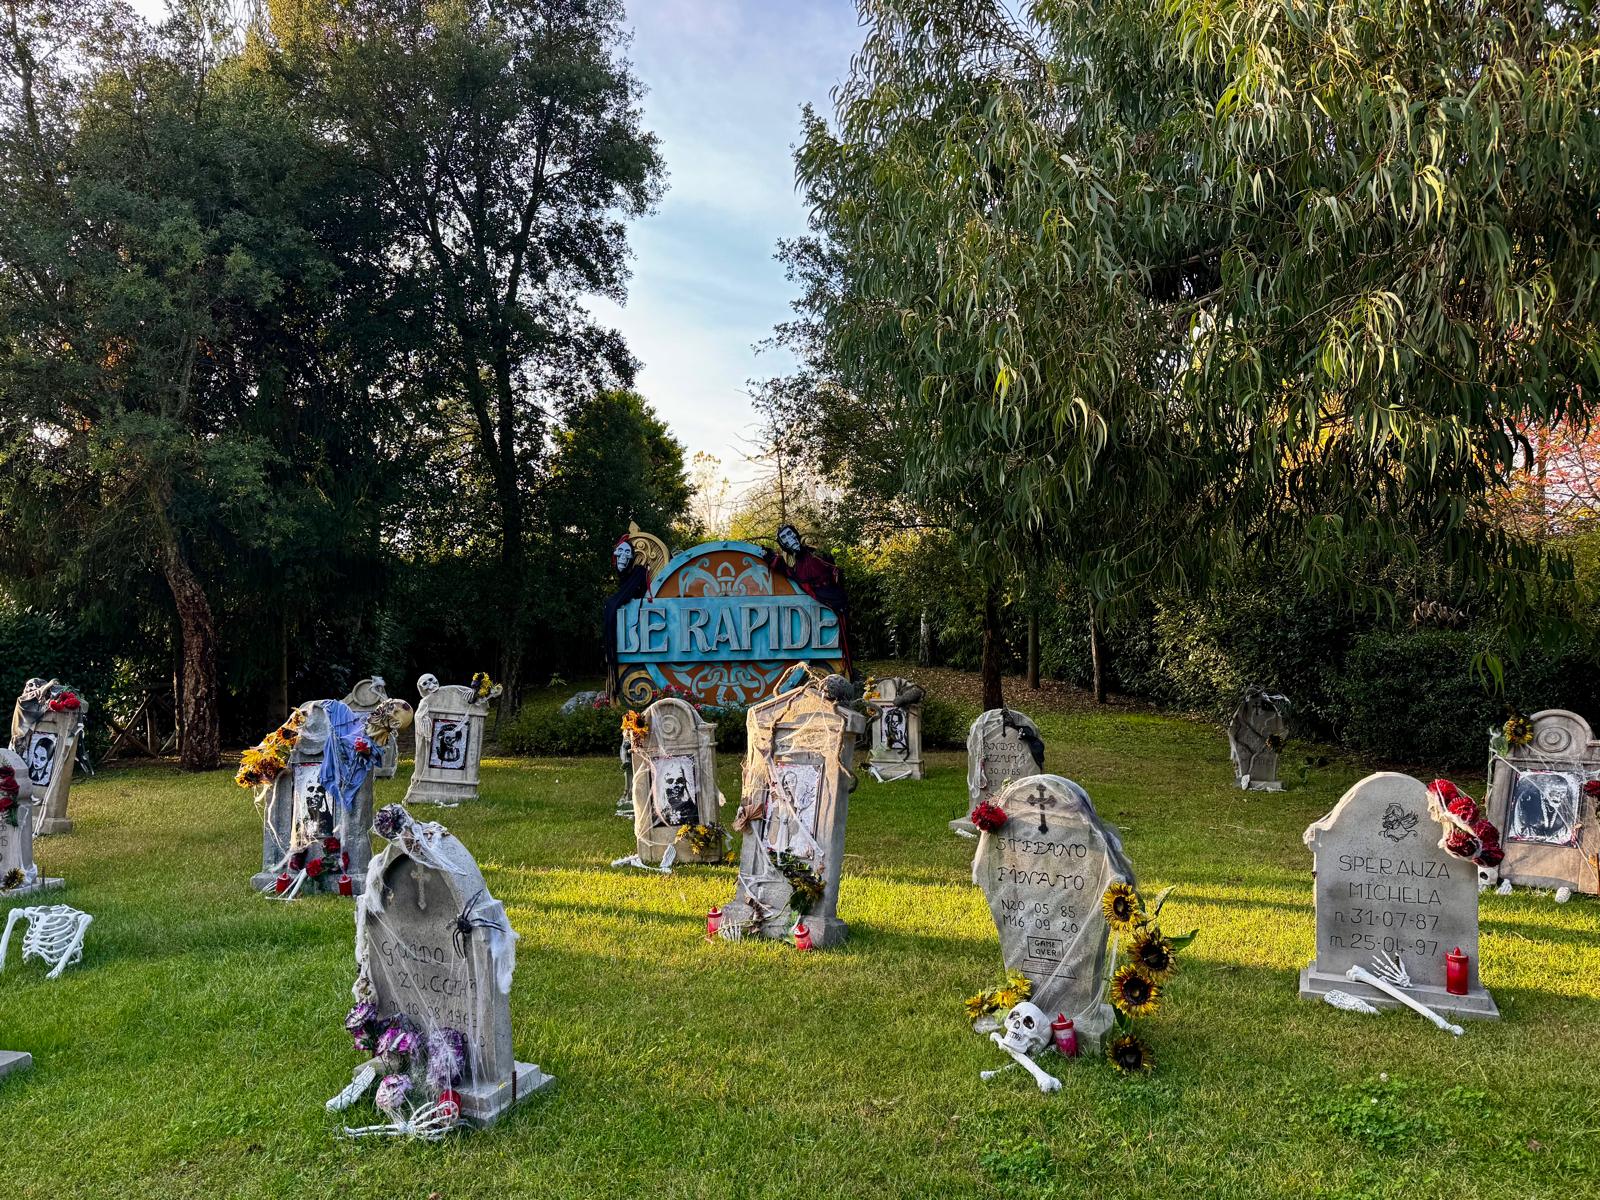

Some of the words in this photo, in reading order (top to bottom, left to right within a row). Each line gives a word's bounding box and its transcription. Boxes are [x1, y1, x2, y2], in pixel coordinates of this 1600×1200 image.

[617, 608, 668, 653] LE
[680, 605, 839, 652] RAPIDE
[1339, 855, 1450, 879] SPERANZA
[997, 865, 1085, 890] FINATO
[1349, 881, 1442, 905] MICHELA
[1034, 903, 1050, 915] 05
[1060, 905, 1076, 919] 85
[1035, 919, 1051, 931] 09
[1061, 921, 1079, 934] 20
[1034, 940, 1055, 948] GAME
[1035, 949, 1057, 957] OVER
